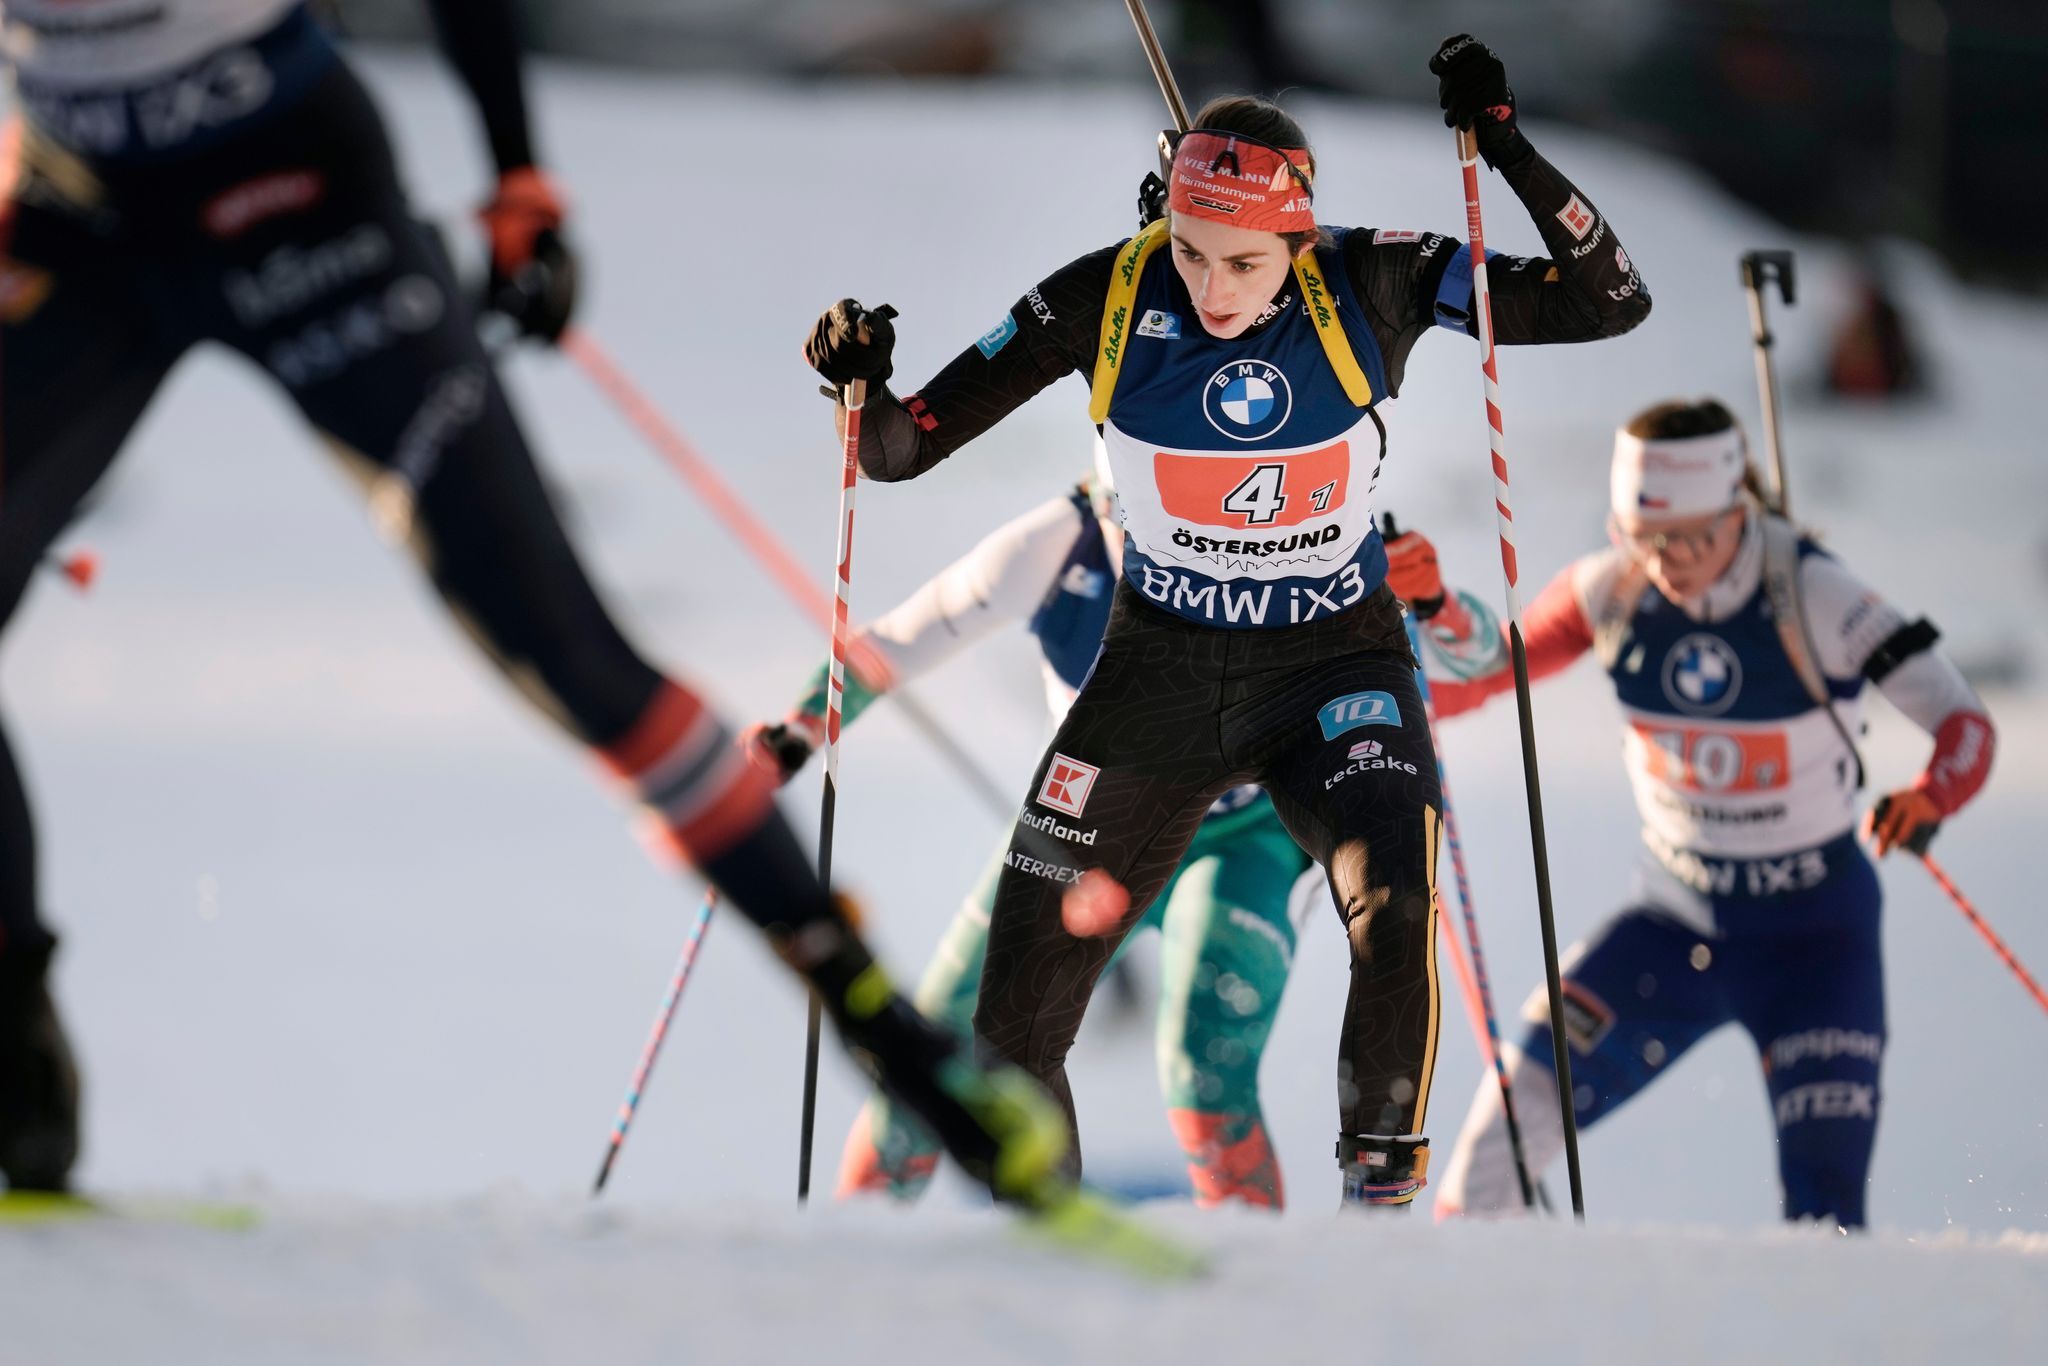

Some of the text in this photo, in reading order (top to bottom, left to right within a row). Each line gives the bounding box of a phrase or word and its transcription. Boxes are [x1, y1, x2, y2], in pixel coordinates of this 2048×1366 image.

[1178, 173, 1266, 203] Wärmepumpen
[1420, 231, 1445, 257] Kau
[1301, 266, 1332, 329] Libella
[1104, 305, 1128, 369] Libella
[1214, 363, 1279, 389] BMW
[1222, 463, 1287, 526] 4
[1171, 523, 1342, 558] ÖSTERSUND
[1142, 562, 1366, 625] BMW iX3
[1327, 695, 1389, 724] TQ
[1324, 756, 1418, 791] tectake
[1654, 730, 1743, 792] 10
[1019, 804, 1098, 846] Kaufland
[1014, 853, 1085, 885] TERREX
